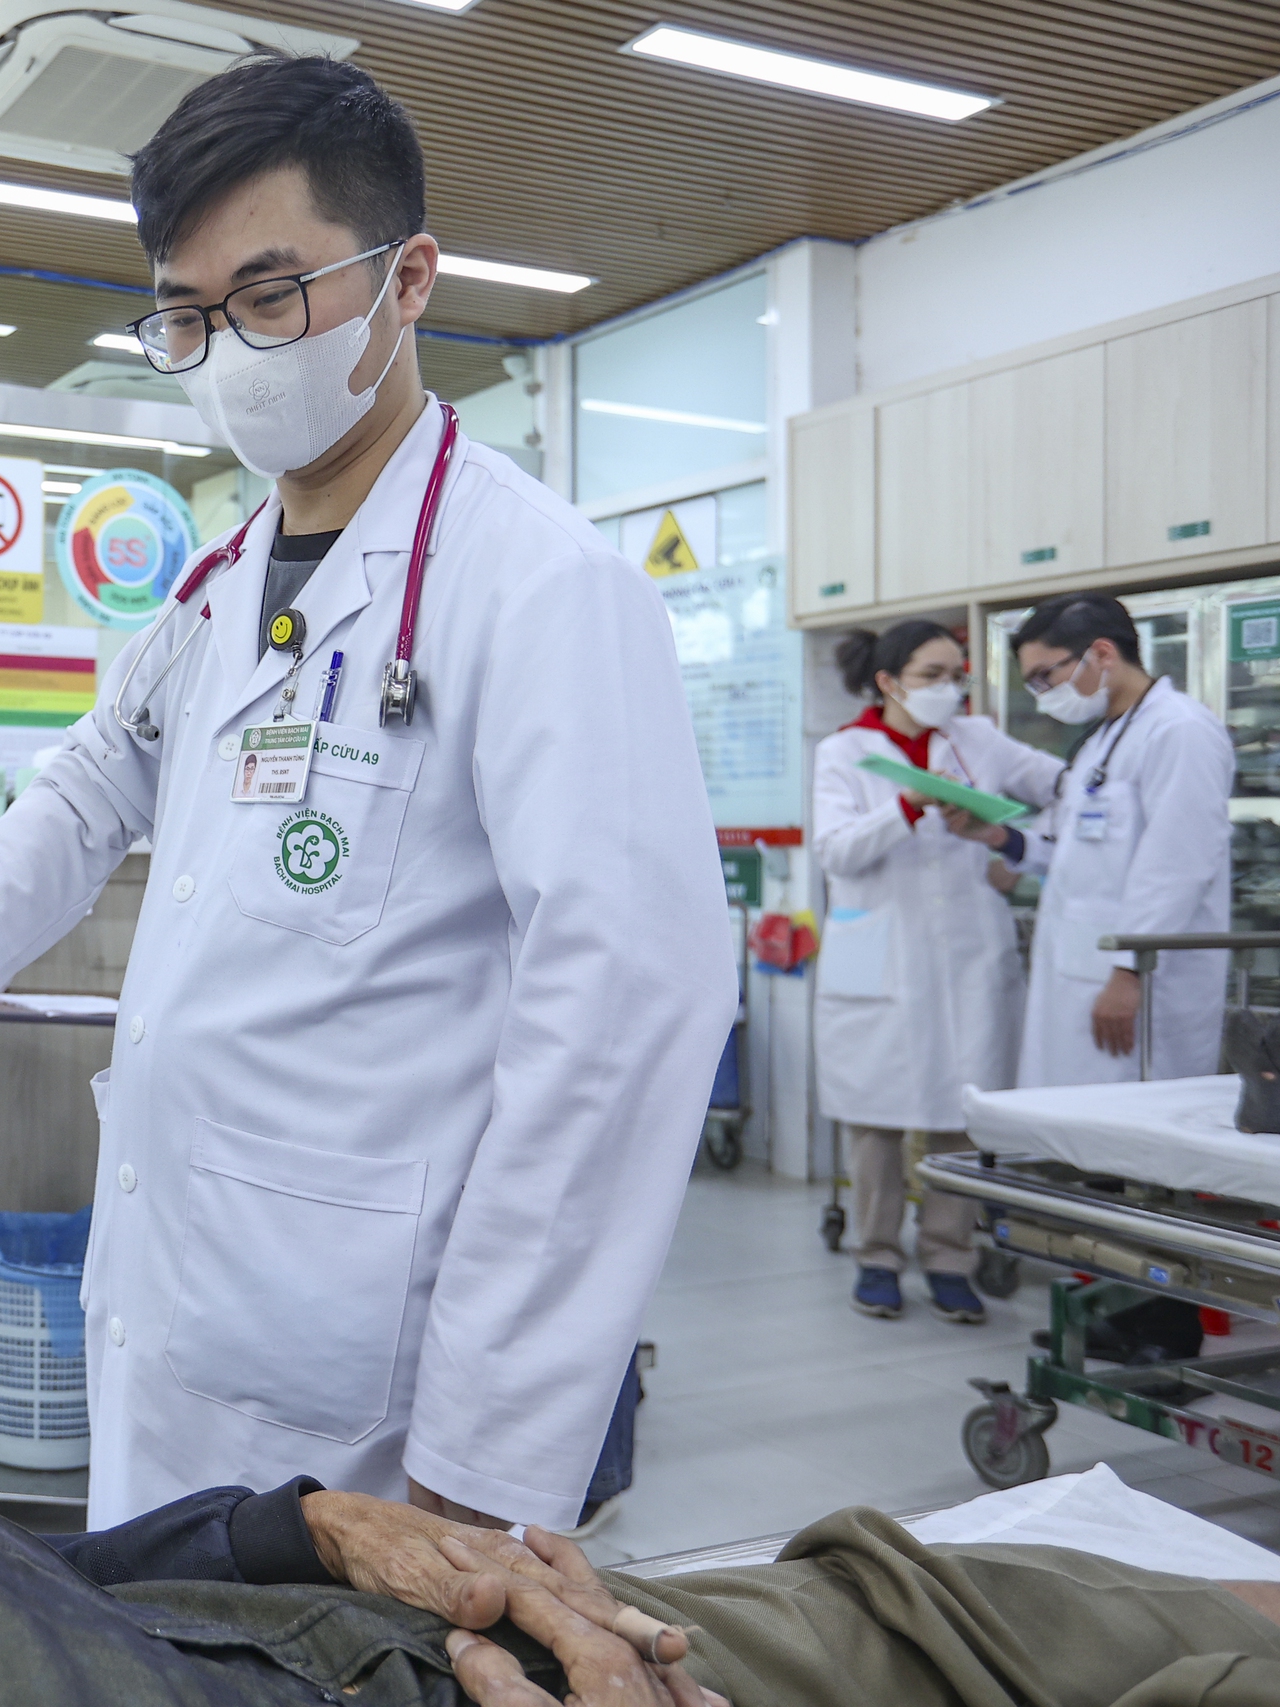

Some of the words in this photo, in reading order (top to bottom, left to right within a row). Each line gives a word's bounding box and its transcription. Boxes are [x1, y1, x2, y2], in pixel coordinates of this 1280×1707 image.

[108, 537, 148, 568] 5S
[314, 737, 328, 755] ẤP
[331, 743, 360, 761] CỨU
[361, 751, 379, 765] A9
[276, 815, 294, 839] BỆNH
[294, 807, 318, 820] VIỆN
[320, 812, 345, 836] BẠCH
[340, 836, 350, 858] MAI
[273, 856, 286, 882] BACH
[284, 878, 300, 894] MAI
[301, 872, 343, 895] HOSPITAL
[1239, 1439, 1273, 1472] 12
